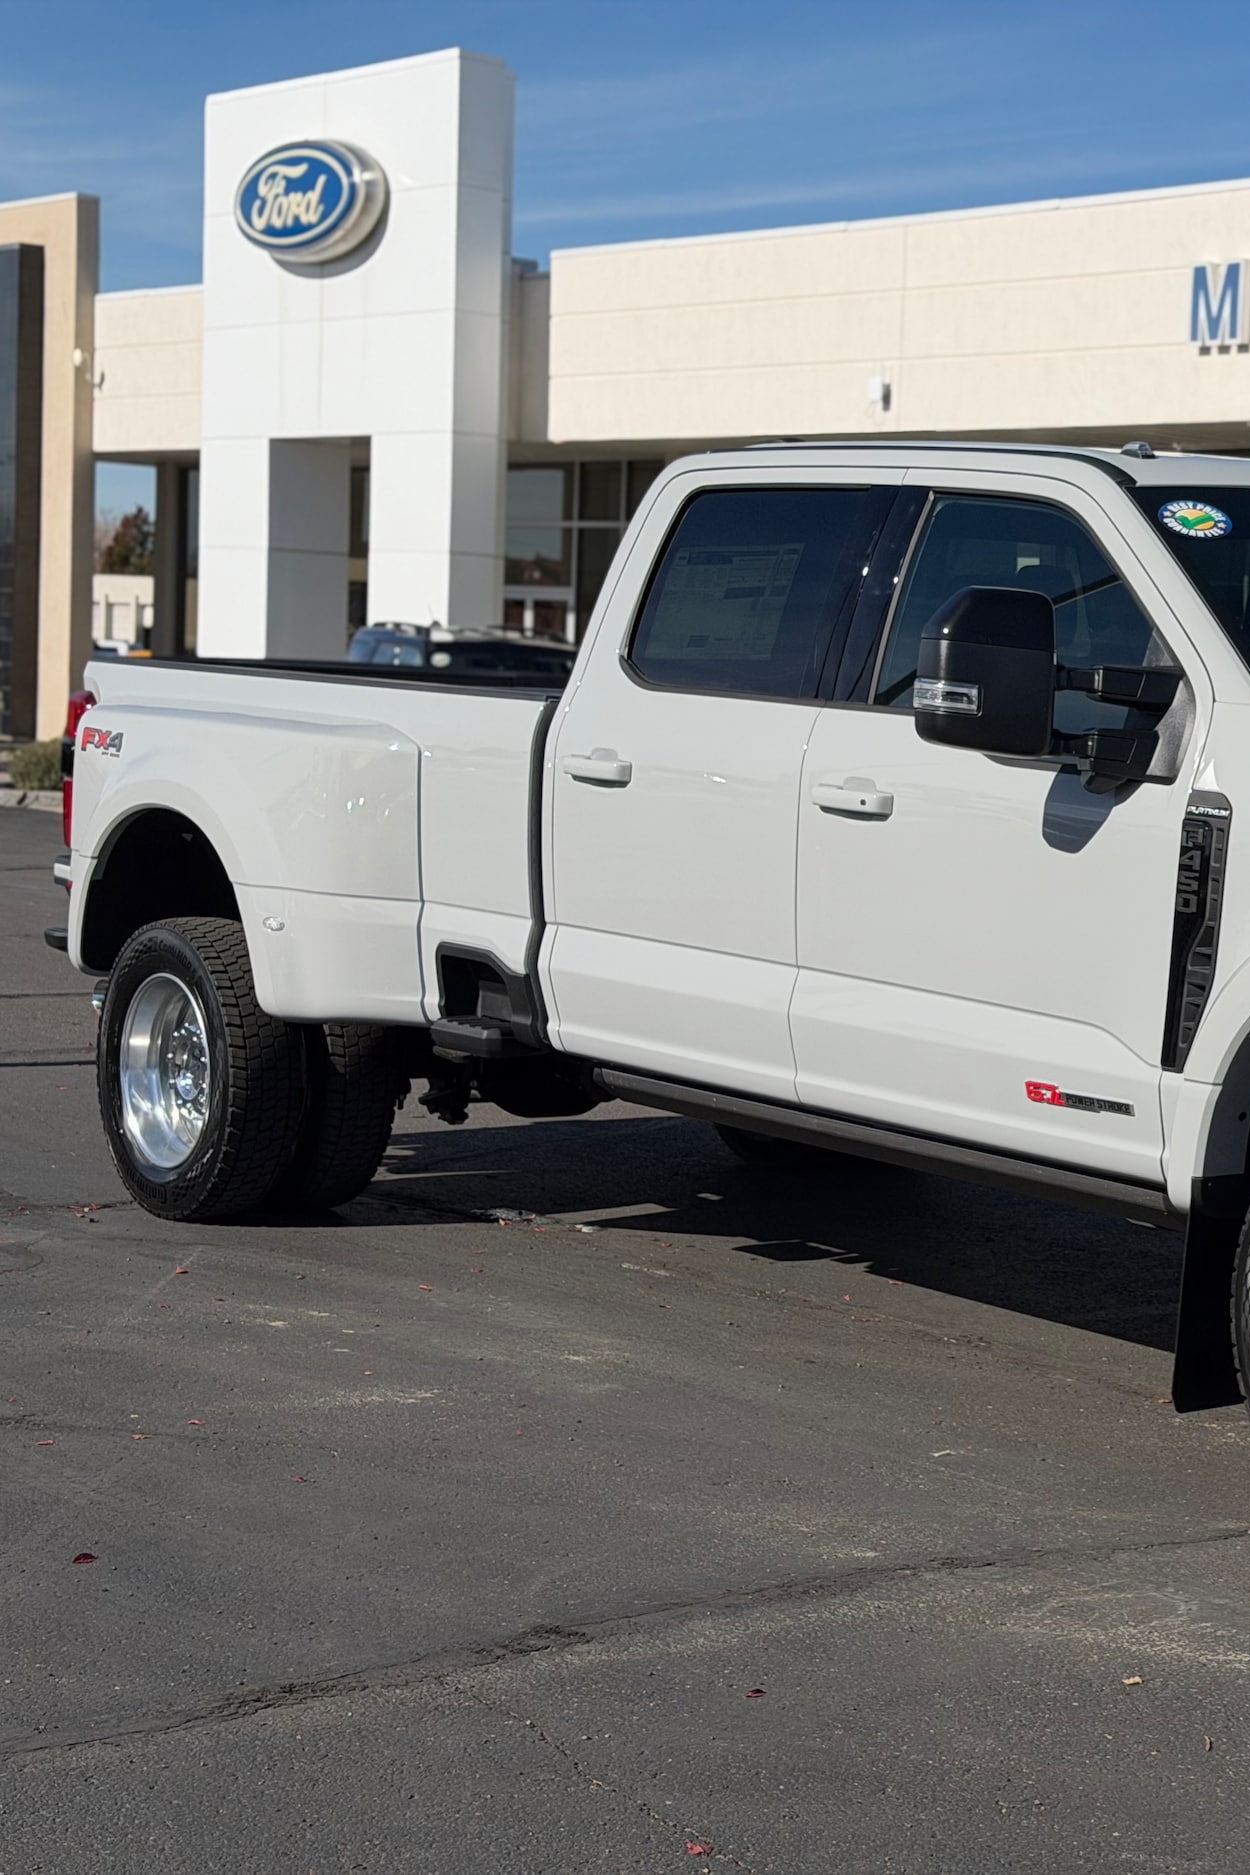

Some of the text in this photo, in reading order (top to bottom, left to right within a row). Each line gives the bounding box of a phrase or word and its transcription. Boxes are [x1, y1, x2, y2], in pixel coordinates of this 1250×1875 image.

[251, 162, 327, 231] Ford
[1196, 502, 1226, 521] PRICE
[1163, 518, 1225, 537] GUARANTEE
[81, 726, 124, 753] FX4
[1187, 805, 1231, 817] PLATINUM
[1065, 1093, 1096, 1108] POWER
[1097, 1098, 1132, 1114] STROKE
